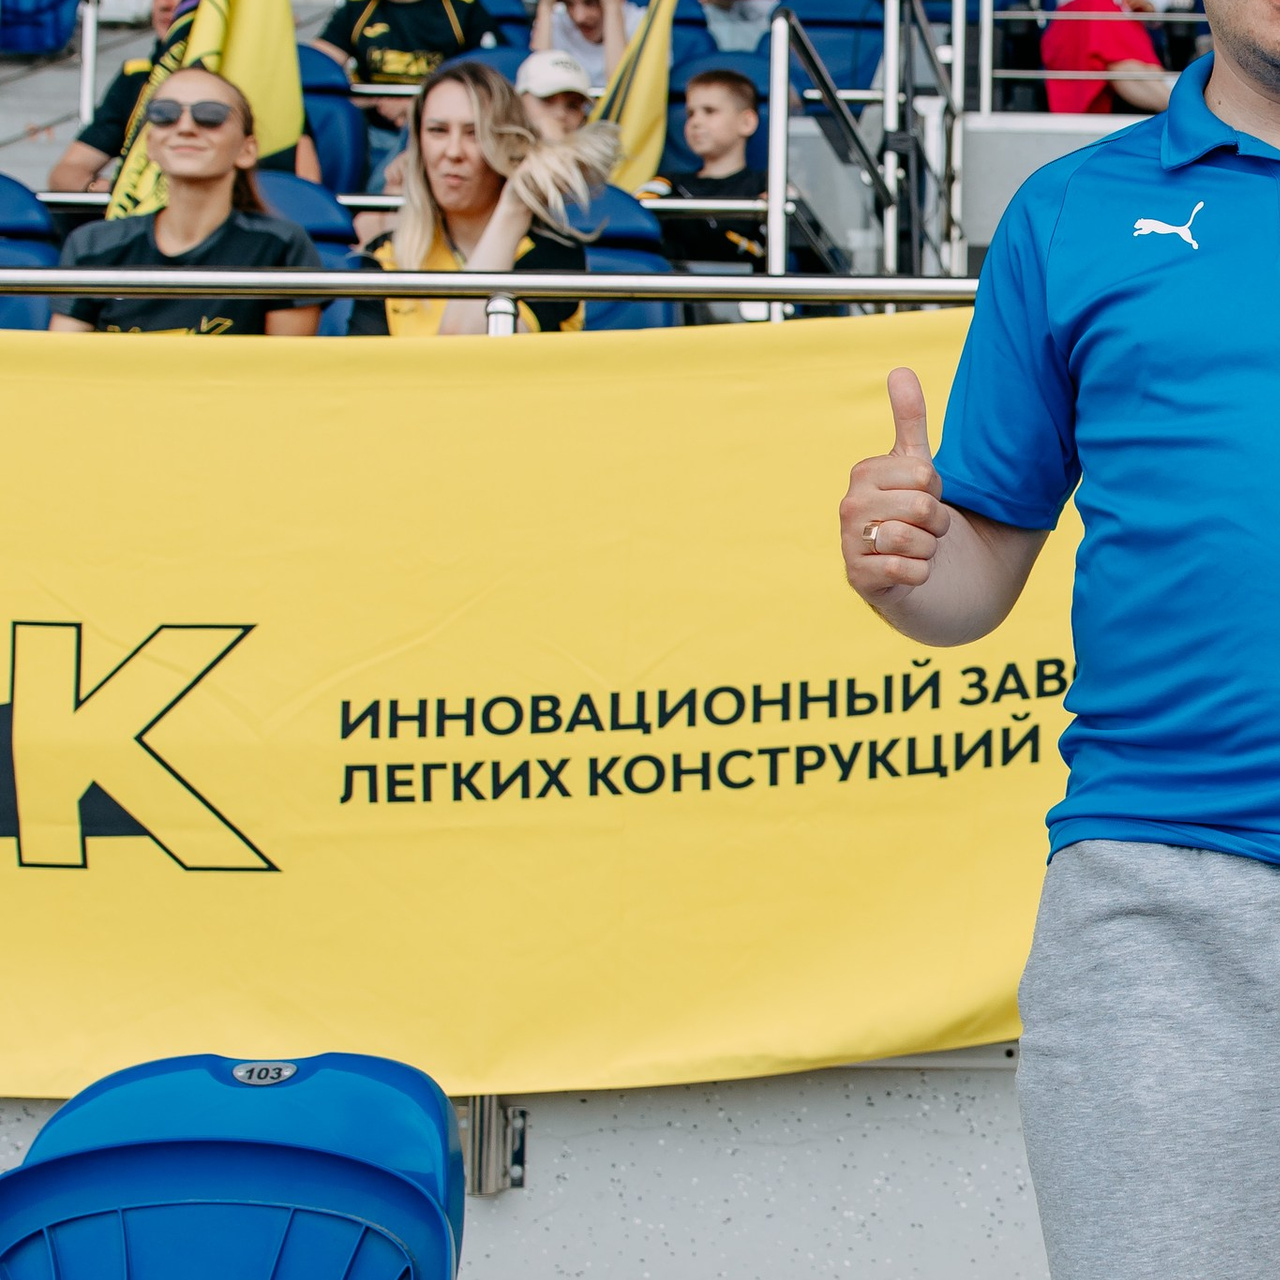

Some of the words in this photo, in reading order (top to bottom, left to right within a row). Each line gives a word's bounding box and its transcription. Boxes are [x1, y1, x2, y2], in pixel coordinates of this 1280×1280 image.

[340, 658, 941, 740] ИННОВАЦИОННЫЙ
[959, 658, 1078, 707] ЗАВ
[339, 757, 572, 804] ЛЕГКИХ
[588, 711, 1041, 797] КОНСТРУКЦИЙ
[245, 1067, 283, 1081] 103
